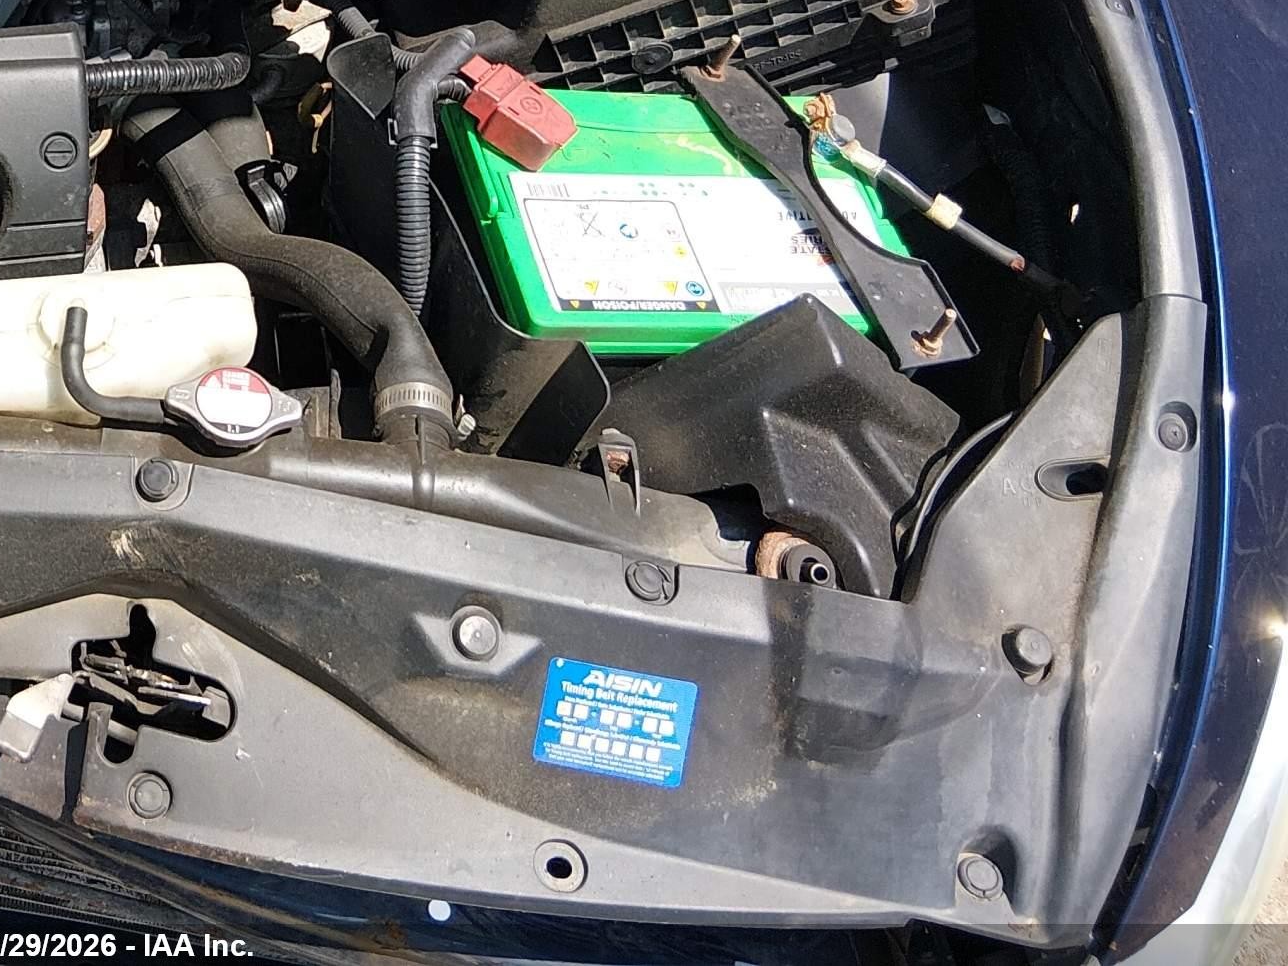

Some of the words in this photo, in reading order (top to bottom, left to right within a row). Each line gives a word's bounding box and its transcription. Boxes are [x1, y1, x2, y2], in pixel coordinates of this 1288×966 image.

[561, 681, 595, 699] Timing
[595, 688, 616, 702] Belt
[616, 690, 679, 714] Replacement
[582, 669, 663, 698] AISIN
